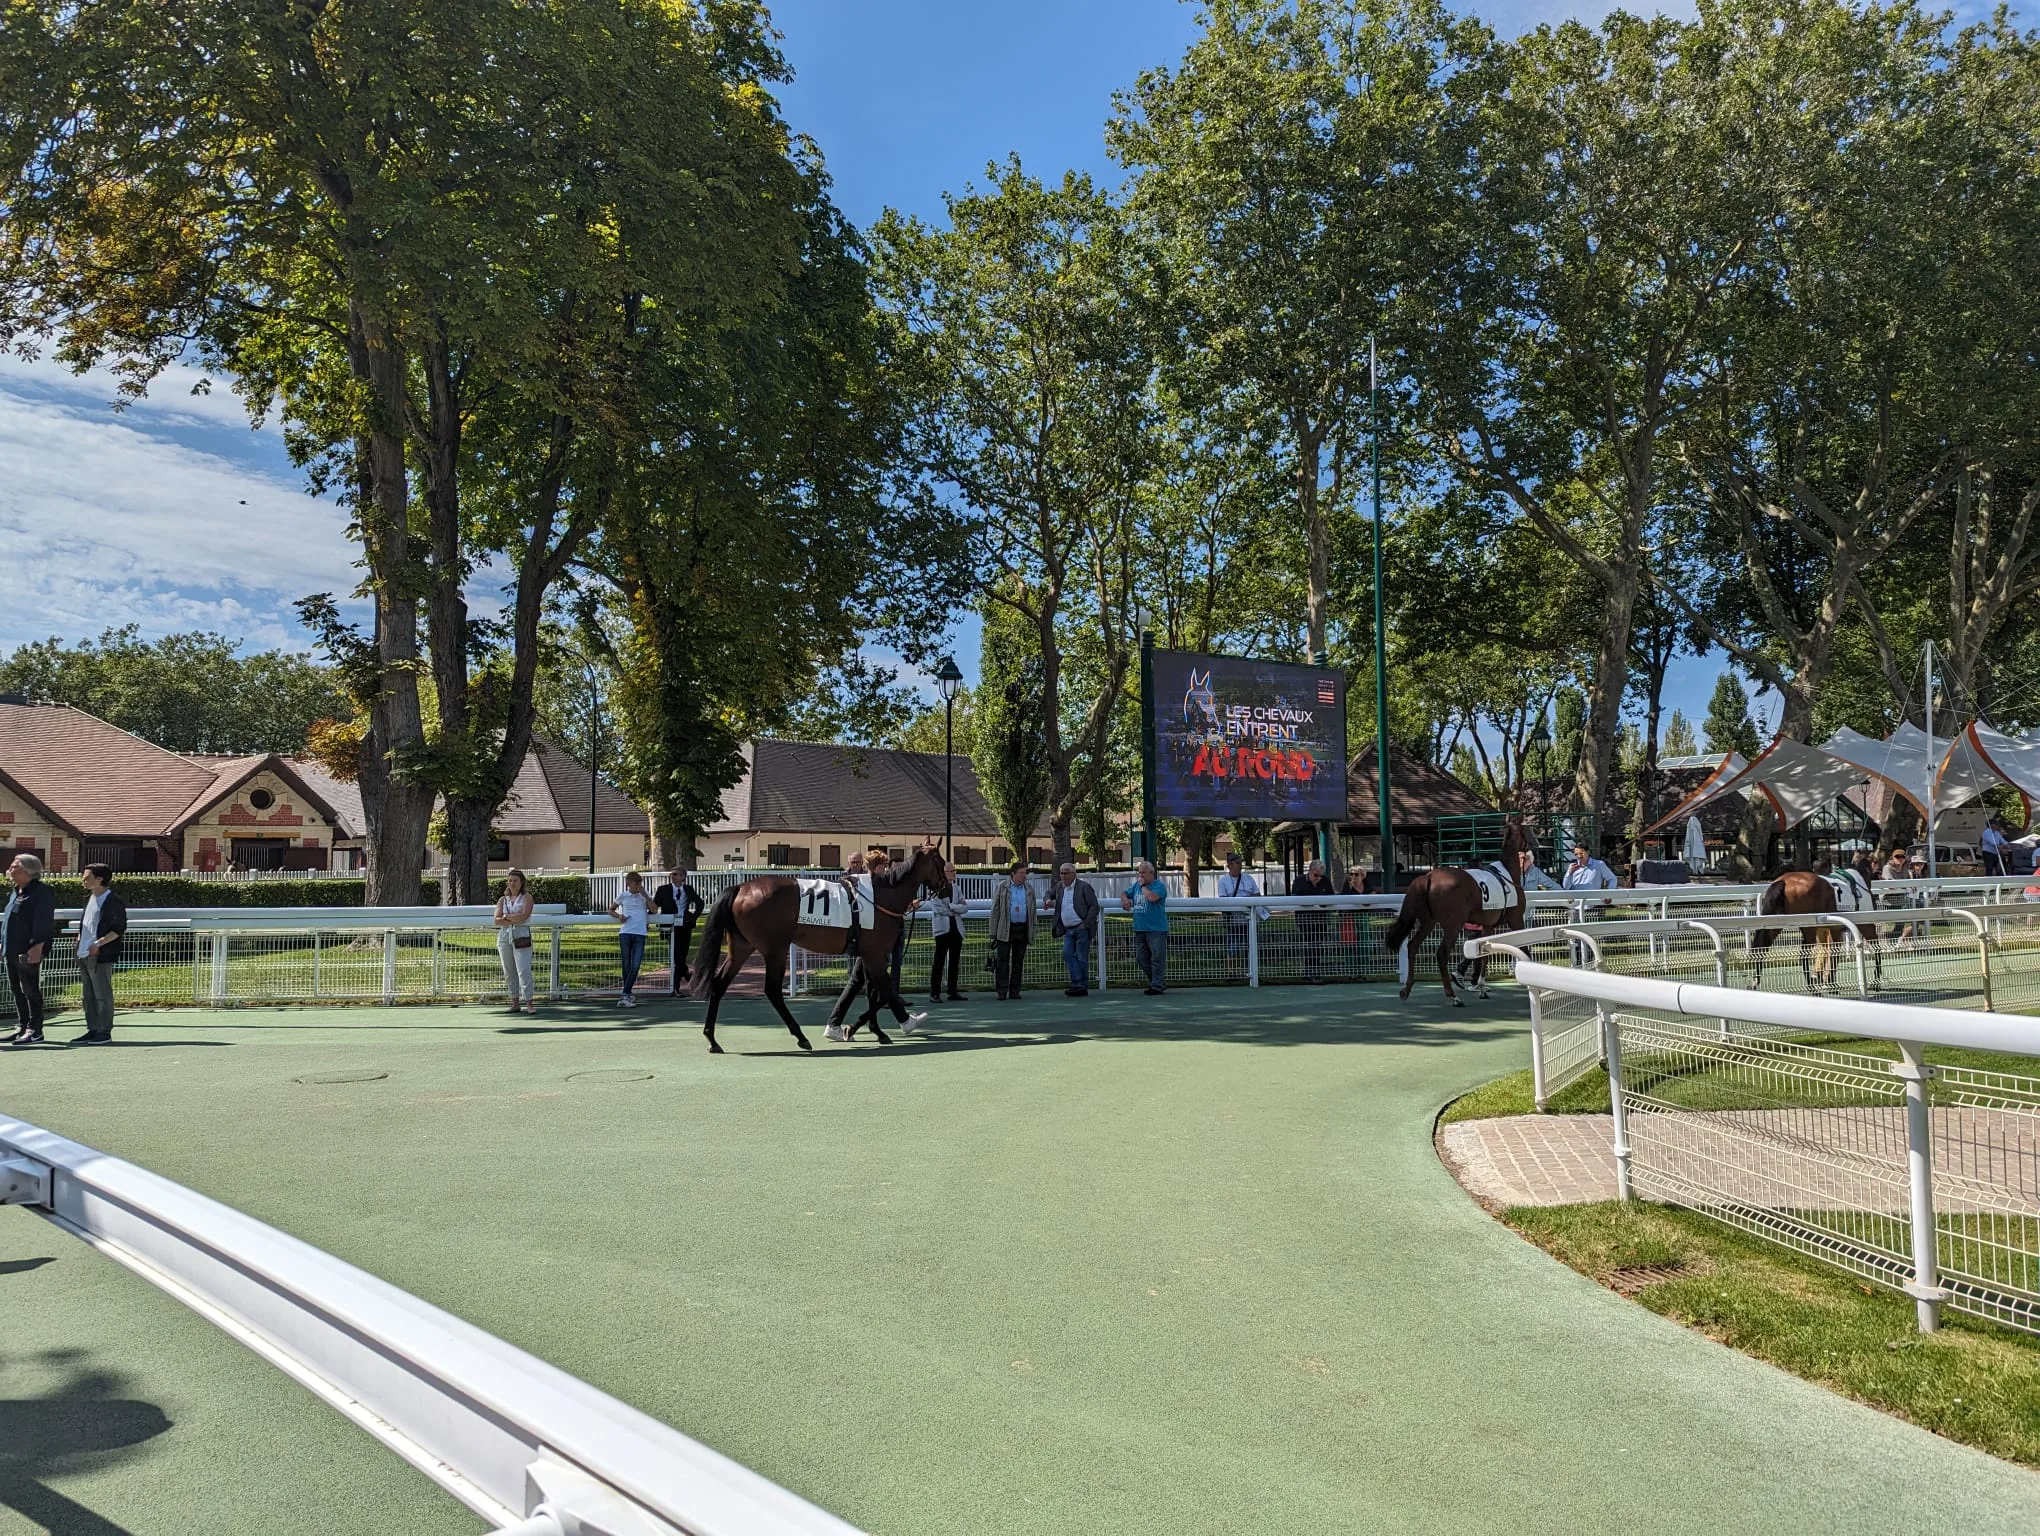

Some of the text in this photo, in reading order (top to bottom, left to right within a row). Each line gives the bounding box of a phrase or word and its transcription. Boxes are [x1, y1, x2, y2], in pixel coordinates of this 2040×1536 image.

[1226, 705, 1314, 723] LES CHEVAUX
[1226, 720, 1299, 739] ENTRENT
[1192, 743, 1314, 780] AU ROND
[801, 887, 830, 916] 11
[1479, 881, 1490, 902] 9
